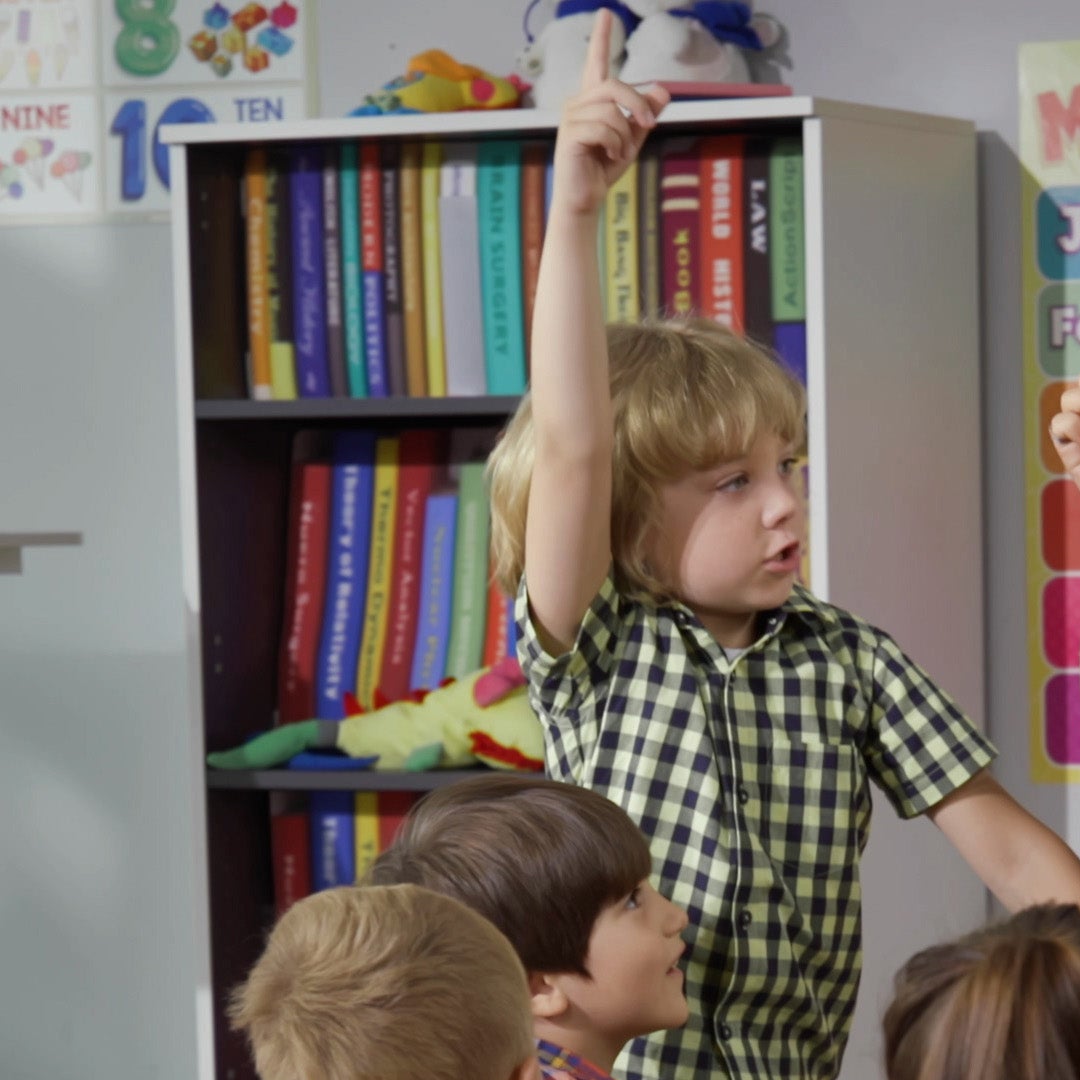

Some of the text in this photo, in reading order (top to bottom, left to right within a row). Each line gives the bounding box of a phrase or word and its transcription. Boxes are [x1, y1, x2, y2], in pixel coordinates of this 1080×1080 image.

[114, 0, 181, 77] 8
[2, 104, 70, 131] NINE
[234, 98, 284, 122] TEN
[711, 159, 733, 326] WORLD HISTO
[751, 180, 767, 253] LAW
[780, 157, 798, 307] ActionScrip
[490, 241, 508, 356] SURGERY
[673, 228, 690, 312] Book
